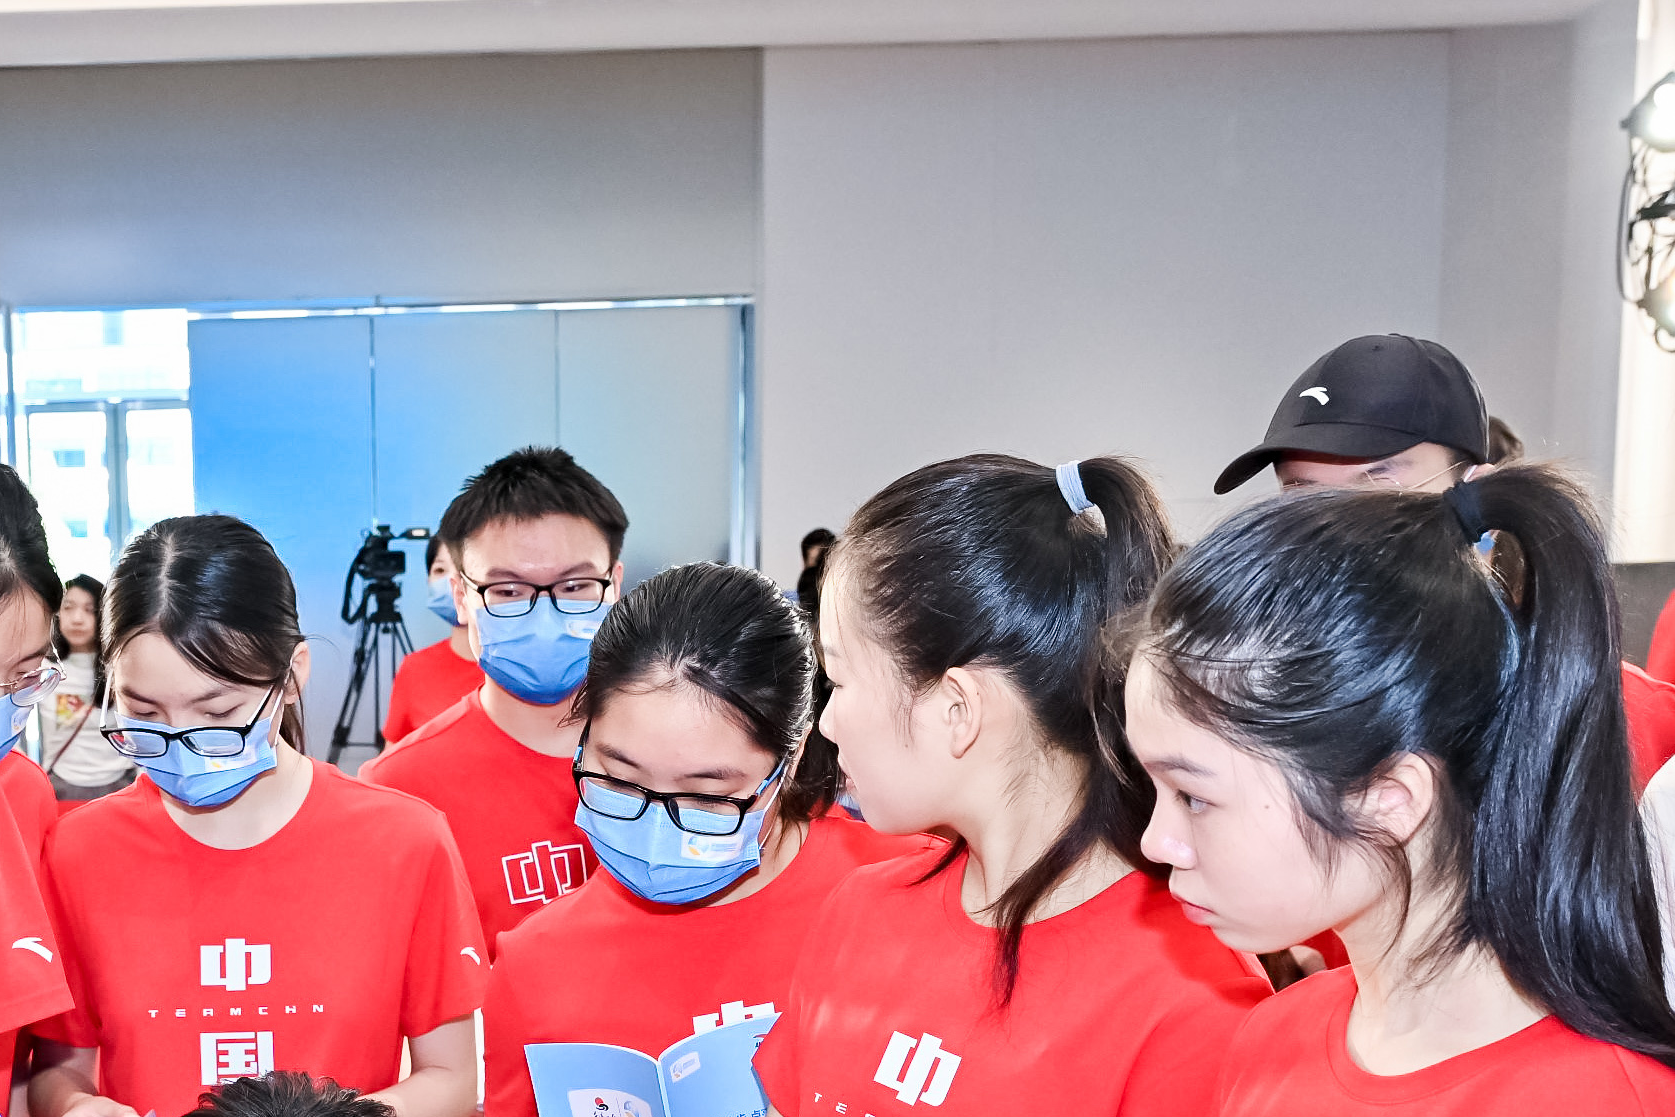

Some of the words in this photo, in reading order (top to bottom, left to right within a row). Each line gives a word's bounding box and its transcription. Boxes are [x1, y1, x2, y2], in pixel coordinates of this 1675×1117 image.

[200, 938, 271, 991] 中
[200, 1031, 274, 1086] 国
[873, 1031, 961, 1107] 中
